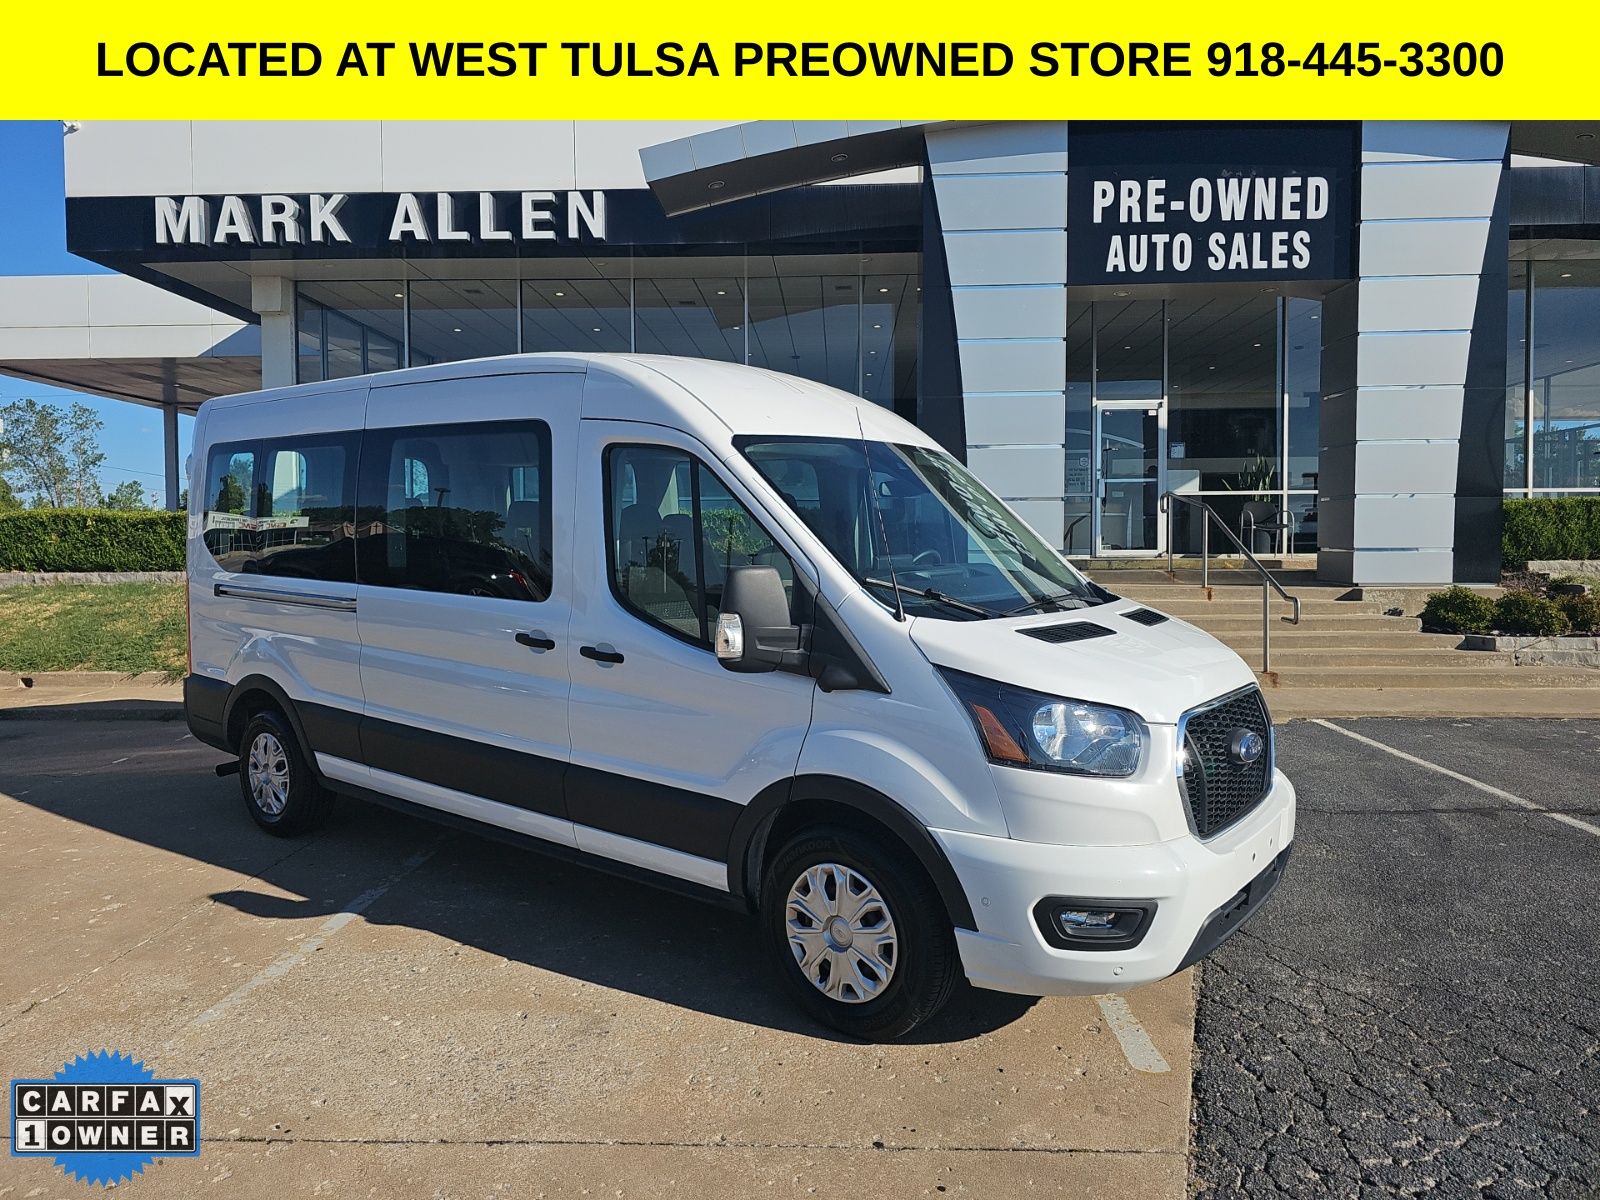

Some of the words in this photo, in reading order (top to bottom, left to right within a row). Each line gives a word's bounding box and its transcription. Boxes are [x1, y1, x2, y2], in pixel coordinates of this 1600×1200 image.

[154, 193, 351, 245] MARK
[388, 191, 607, 242] ALLEN
[1092, 176, 1330, 224] PRE-OWNED
[1105, 232, 1193, 273] AUTO
[1207, 230, 1311, 271] SALES
